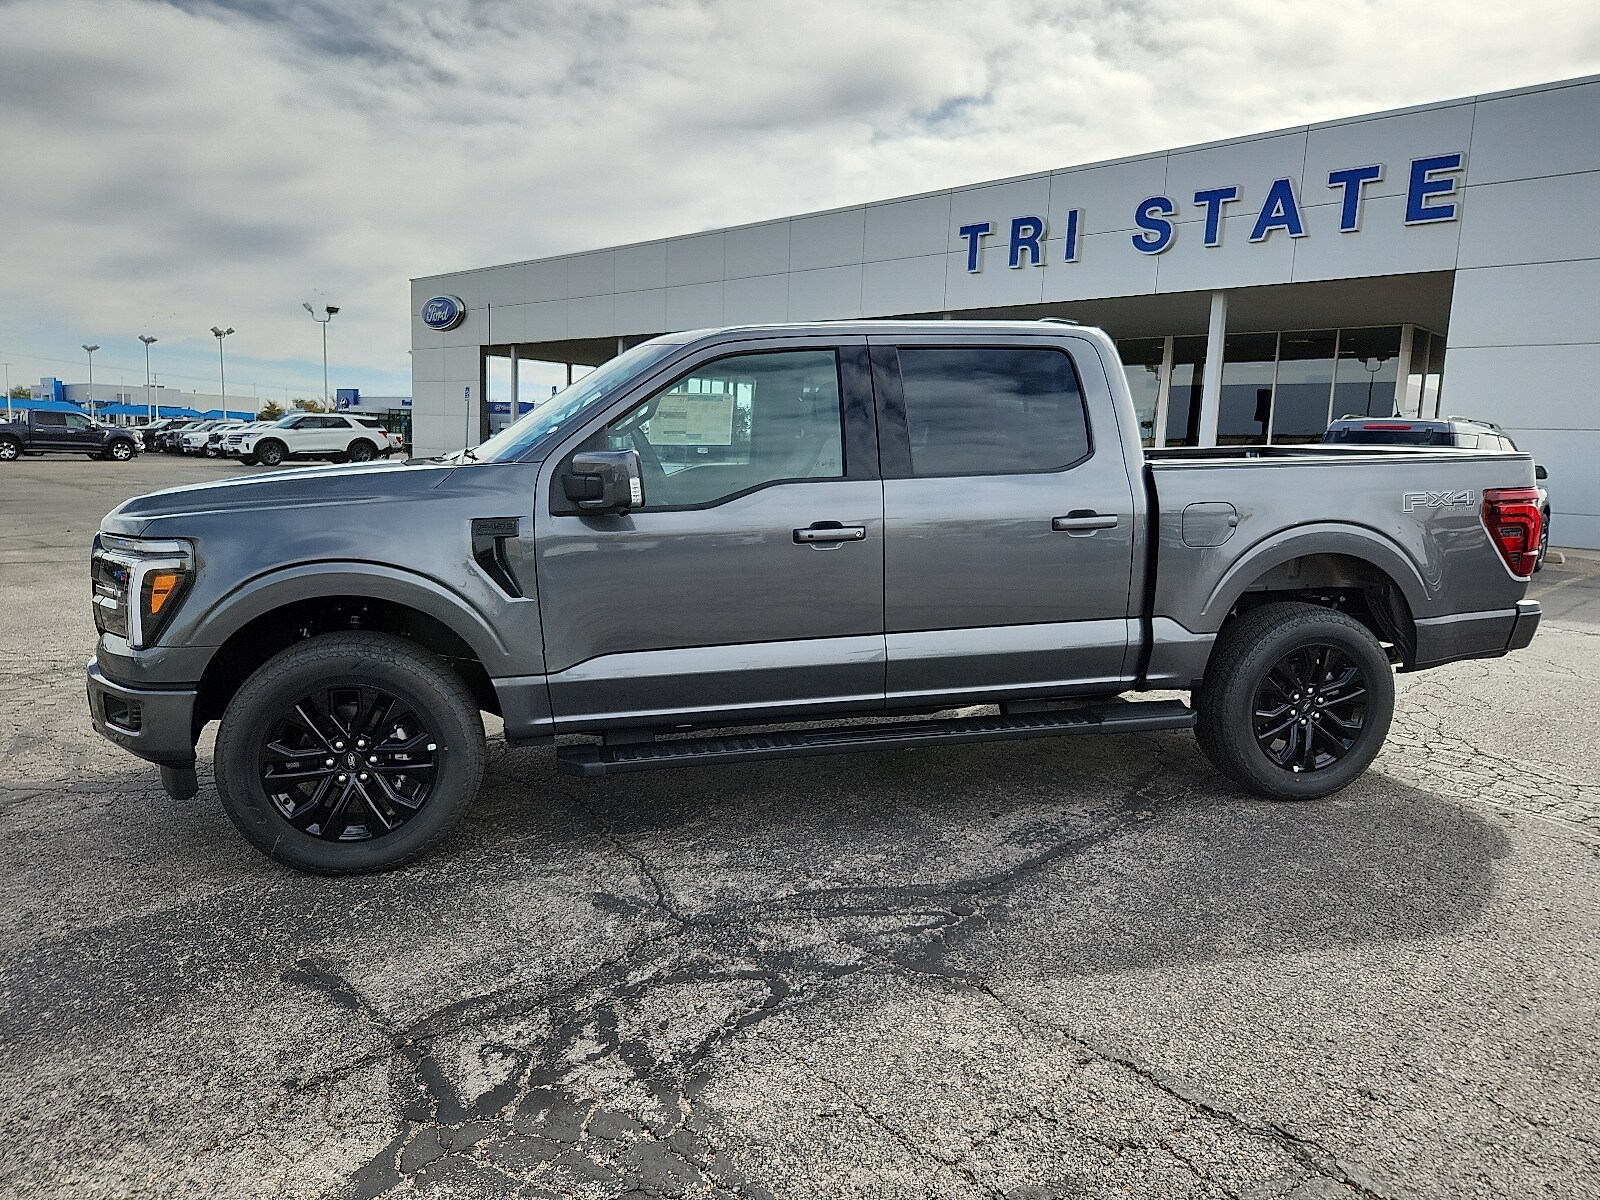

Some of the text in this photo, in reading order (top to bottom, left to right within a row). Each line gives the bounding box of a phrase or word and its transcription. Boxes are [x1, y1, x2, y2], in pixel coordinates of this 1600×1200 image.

[959, 152, 1466, 274] TRI STATE
[427, 303, 449, 321] Ford
[1402, 490, 1474, 513] FX4
